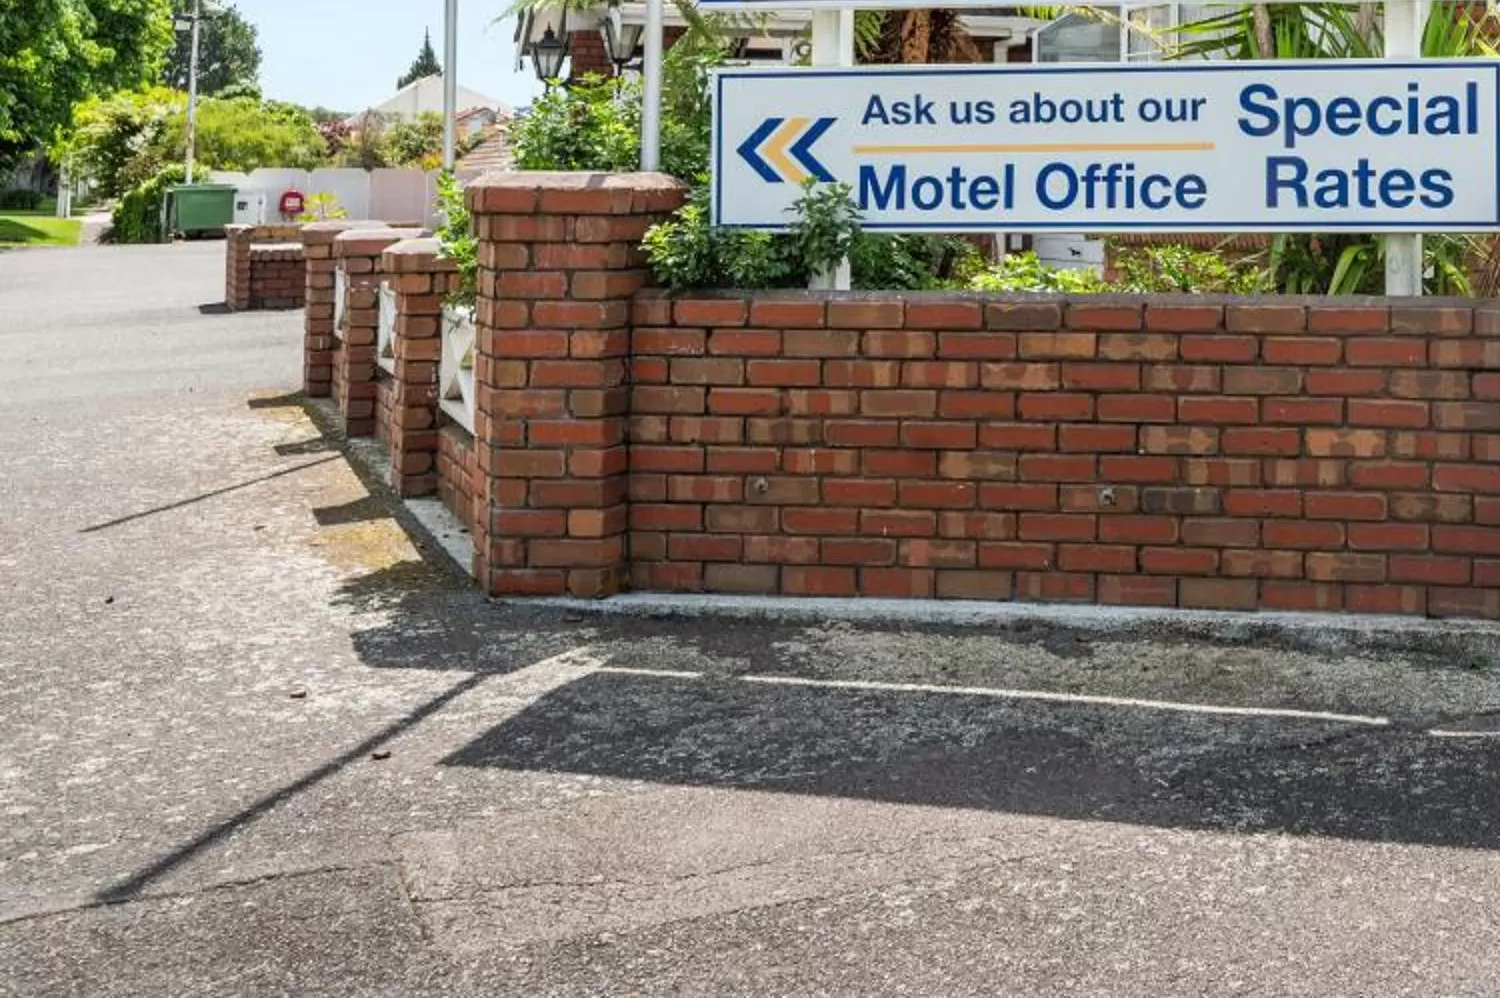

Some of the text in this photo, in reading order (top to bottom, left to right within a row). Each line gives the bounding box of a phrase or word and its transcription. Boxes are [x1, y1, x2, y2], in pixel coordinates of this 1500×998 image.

[861, 91, 1207, 126] Ask us about our
[1237, 81, 1479, 149] Special
[858, 161, 1208, 212] Motel Office
[1265, 155, 1455, 209] Rates
